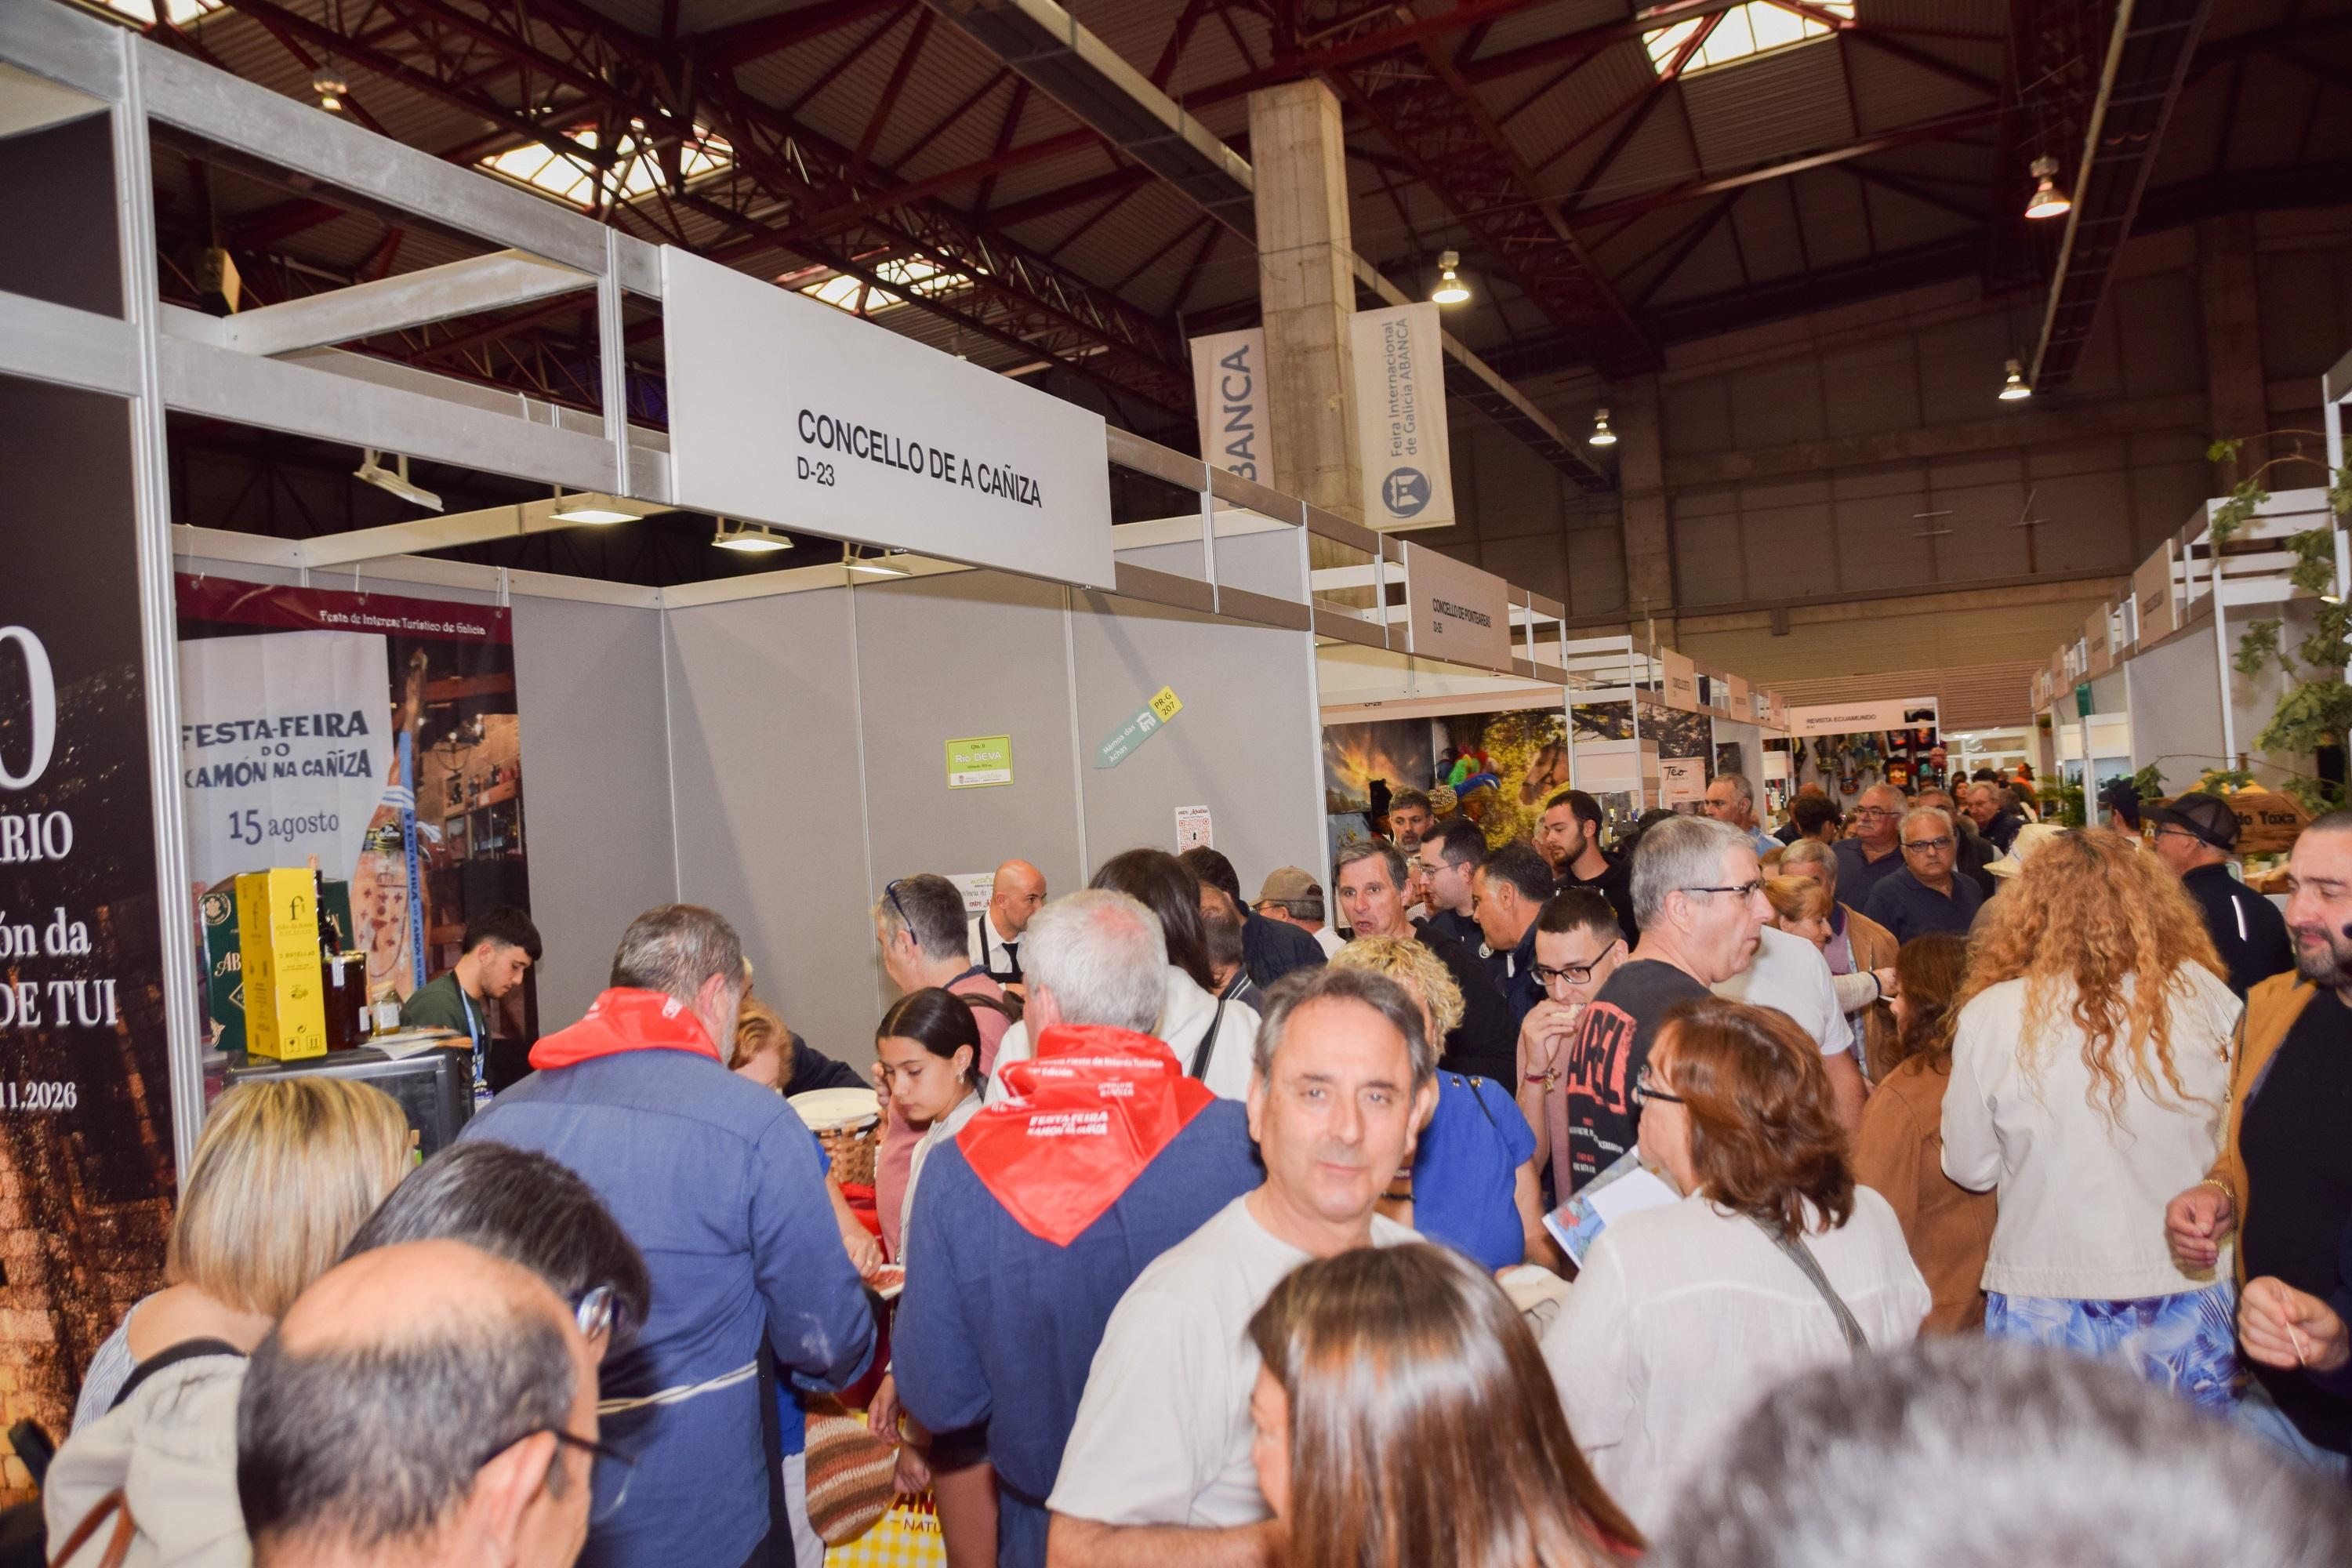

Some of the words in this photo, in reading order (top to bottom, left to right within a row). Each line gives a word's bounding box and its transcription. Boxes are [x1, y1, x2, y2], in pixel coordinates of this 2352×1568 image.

[1396, 318, 1413, 380] ABANCA
[1381, 321, 1400, 419] Internacional
[1402, 383, 1415, 434] Galicia
[1391, 423, 1403, 457] Feira
[1405, 437, 1417, 456] de
[797, 456, 835, 487] D-23
[798, 408, 924, 474] CONCELLO
[929, 448, 956, 484] DE
[960, 459, 975, 489] A
[978, 463, 1042, 509] CAÑIZA
[319, 610, 349, 623] Festa
[350, 613, 361, 624] de
[401, 617, 441, 632] Turístico
[442, 622, 455, 633] de
[456, 622, 485, 635] Galicia
[1432, 597, 1458, 618] CONCELLO
[1465, 608, 1491, 629] PONTEAREAS
[1154, 692, 1172, 710] PR-G
[1161, 702, 1175, 716] 207
[1123, 724, 1136, 737] das
[1835, 713, 1877, 722] ECUAMUNDO
[261, 742, 290, 757] DO
[974, 752, 1003, 761] DEVA
[1109, 745, 1128, 763] Achas
[273, 761, 298, 778] NA
[302, 749, 372, 779] CAÑIZA
[1663, 765, 1688, 781] Teo
[229, 809, 263, 845] 15
[268, 811, 339, 842] agosto
[2258, 811, 2296, 825] Toxa
[45, 906, 92, 956] da
[47, 979, 118, 1028] TUI
